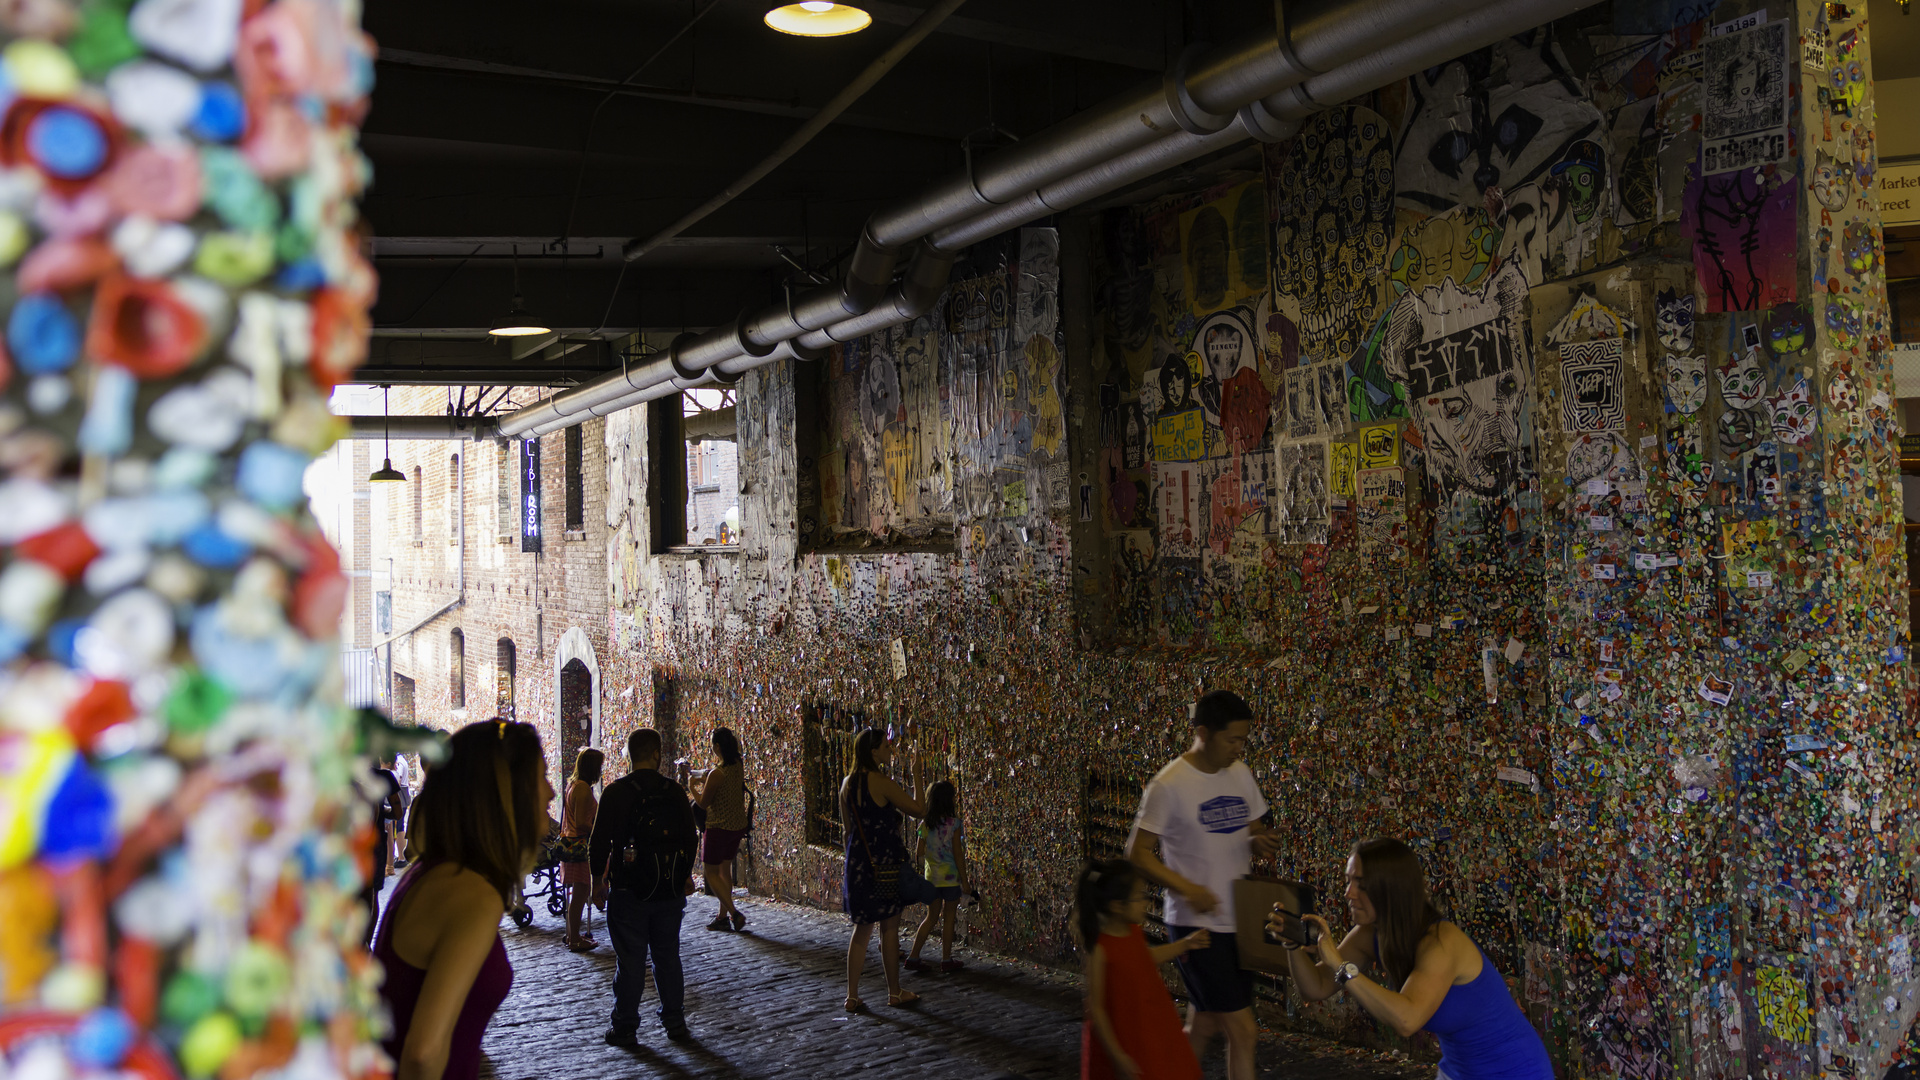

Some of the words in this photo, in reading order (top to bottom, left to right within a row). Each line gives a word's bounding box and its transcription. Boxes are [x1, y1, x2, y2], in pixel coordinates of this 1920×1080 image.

[1726, 17, 1756, 33] miss
[1154, 417, 1176, 436] THIS
[1184, 412, 1195, 431] IS
[886, 449, 911, 459] DINGUS
[1155, 440, 1200, 460] THERAPY
[526, 437, 536, 493] LIBI
[527, 495, 537, 536] ROOM
